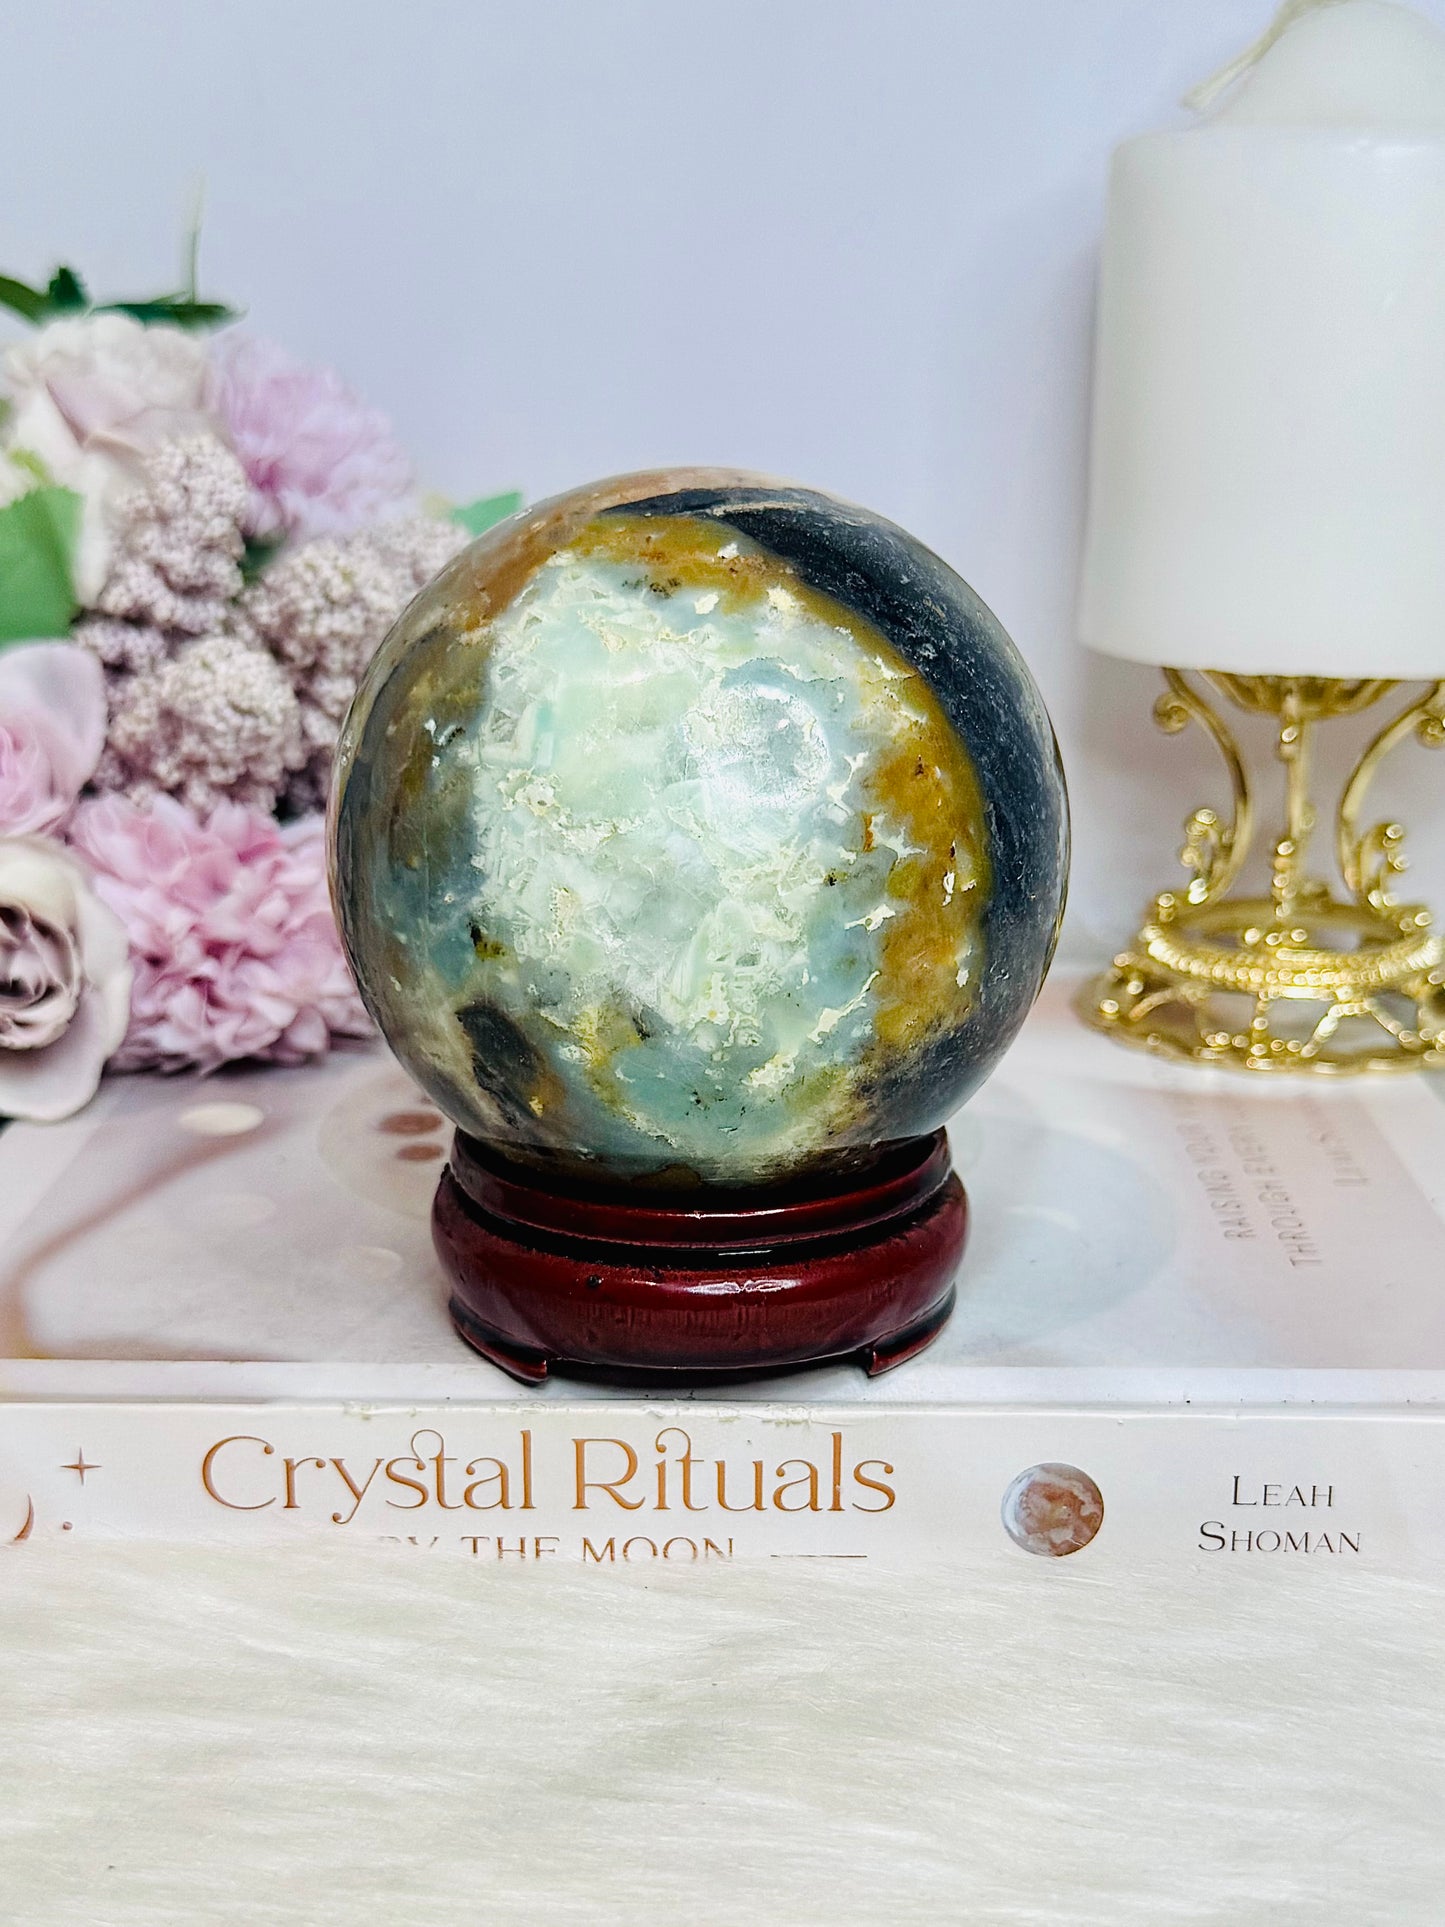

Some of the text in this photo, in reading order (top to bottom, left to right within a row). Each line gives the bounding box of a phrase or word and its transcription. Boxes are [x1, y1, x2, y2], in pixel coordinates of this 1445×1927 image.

[1197, 1169, 1256, 1240] RAISING
[1252, 1178, 1323, 1267] THROUGH
[202, 1427, 896, 1525] Crystal Rituals
[1232, 1475, 1333, 1507] LEAH
[582, 1536, 734, 1563] MOON
[1198, 1520, 1361, 1554] SHOMAN
